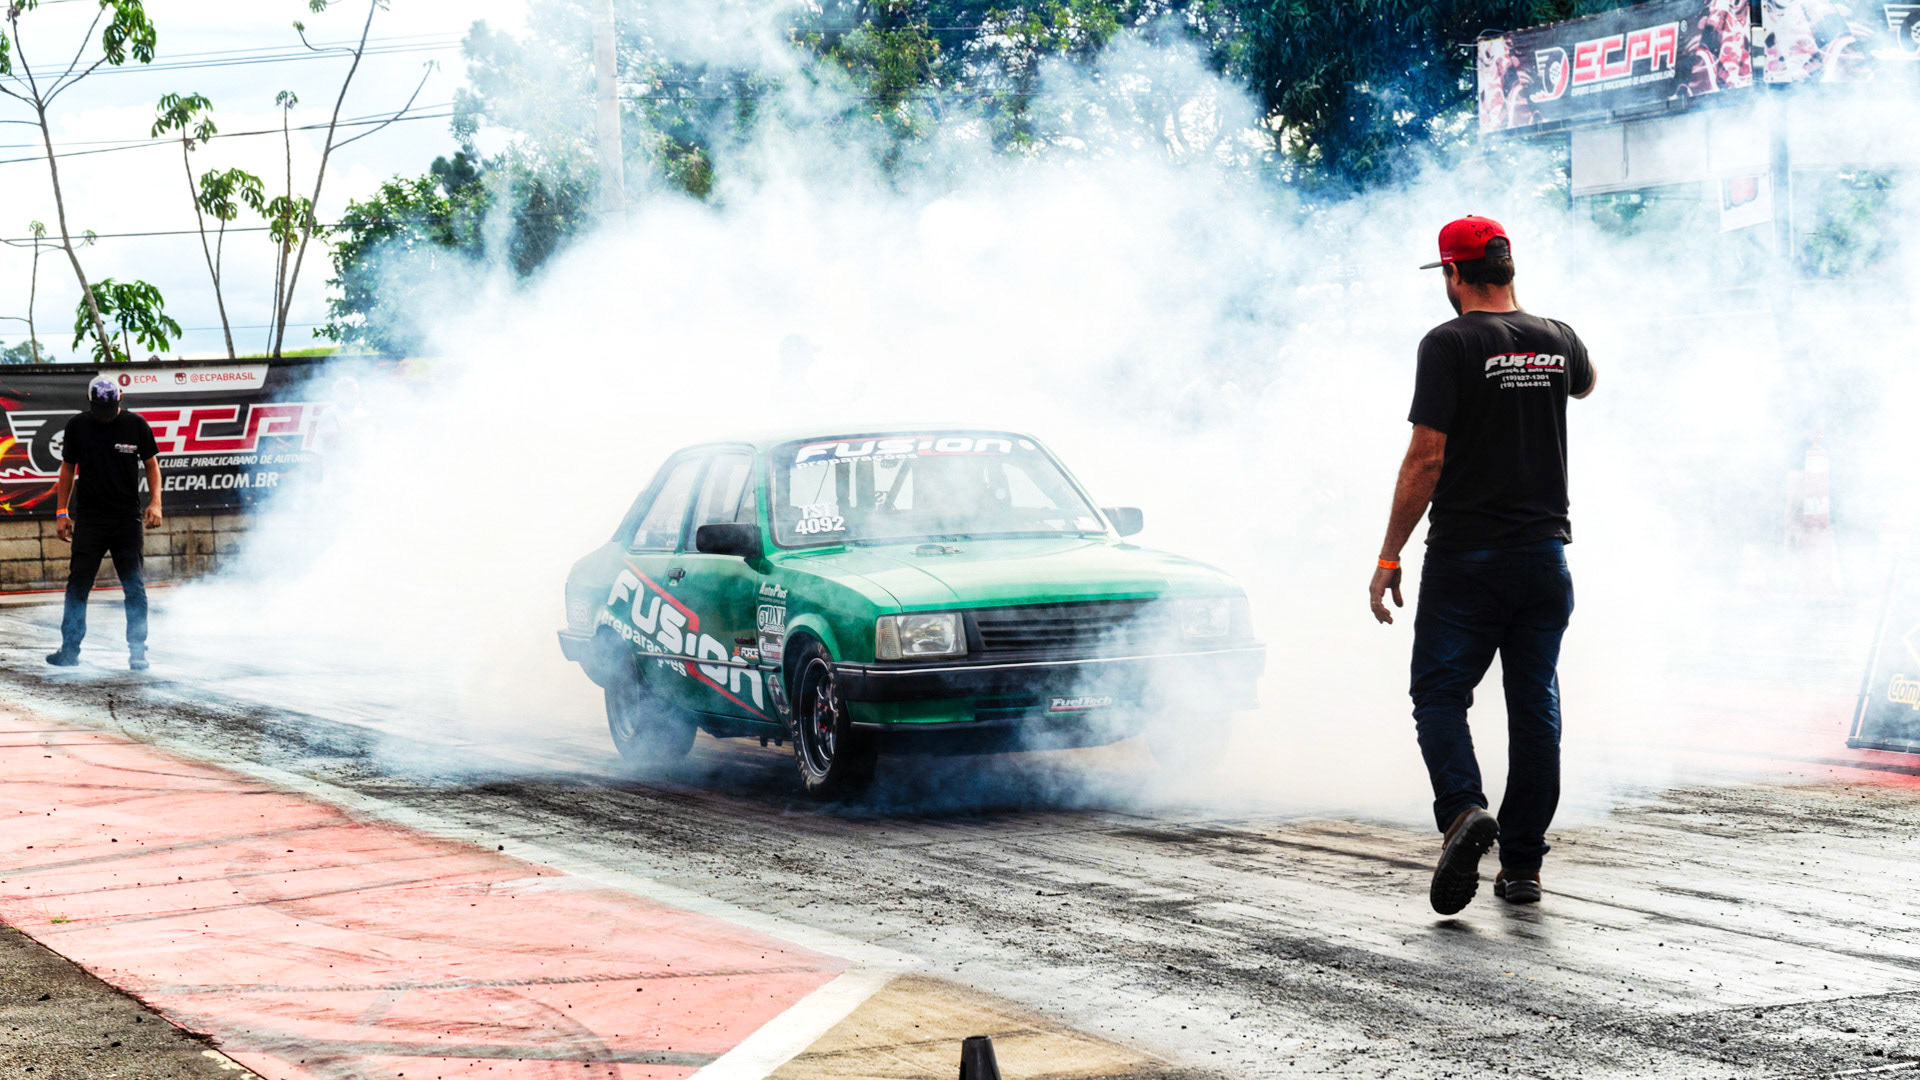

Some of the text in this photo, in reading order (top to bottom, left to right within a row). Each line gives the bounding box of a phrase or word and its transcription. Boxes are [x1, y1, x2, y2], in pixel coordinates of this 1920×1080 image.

[1572, 21, 1679, 87] ECPA
[134, 372, 256, 384] ECPA @ECPABRASIL
[159, 457, 189, 468] CLUBE
[191, 455, 258, 467] PIRACICABANO
[260, 454, 273, 465] DE
[795, 516, 846, 535] 4092
[1051, 695, 1113, 708] FuelTech
